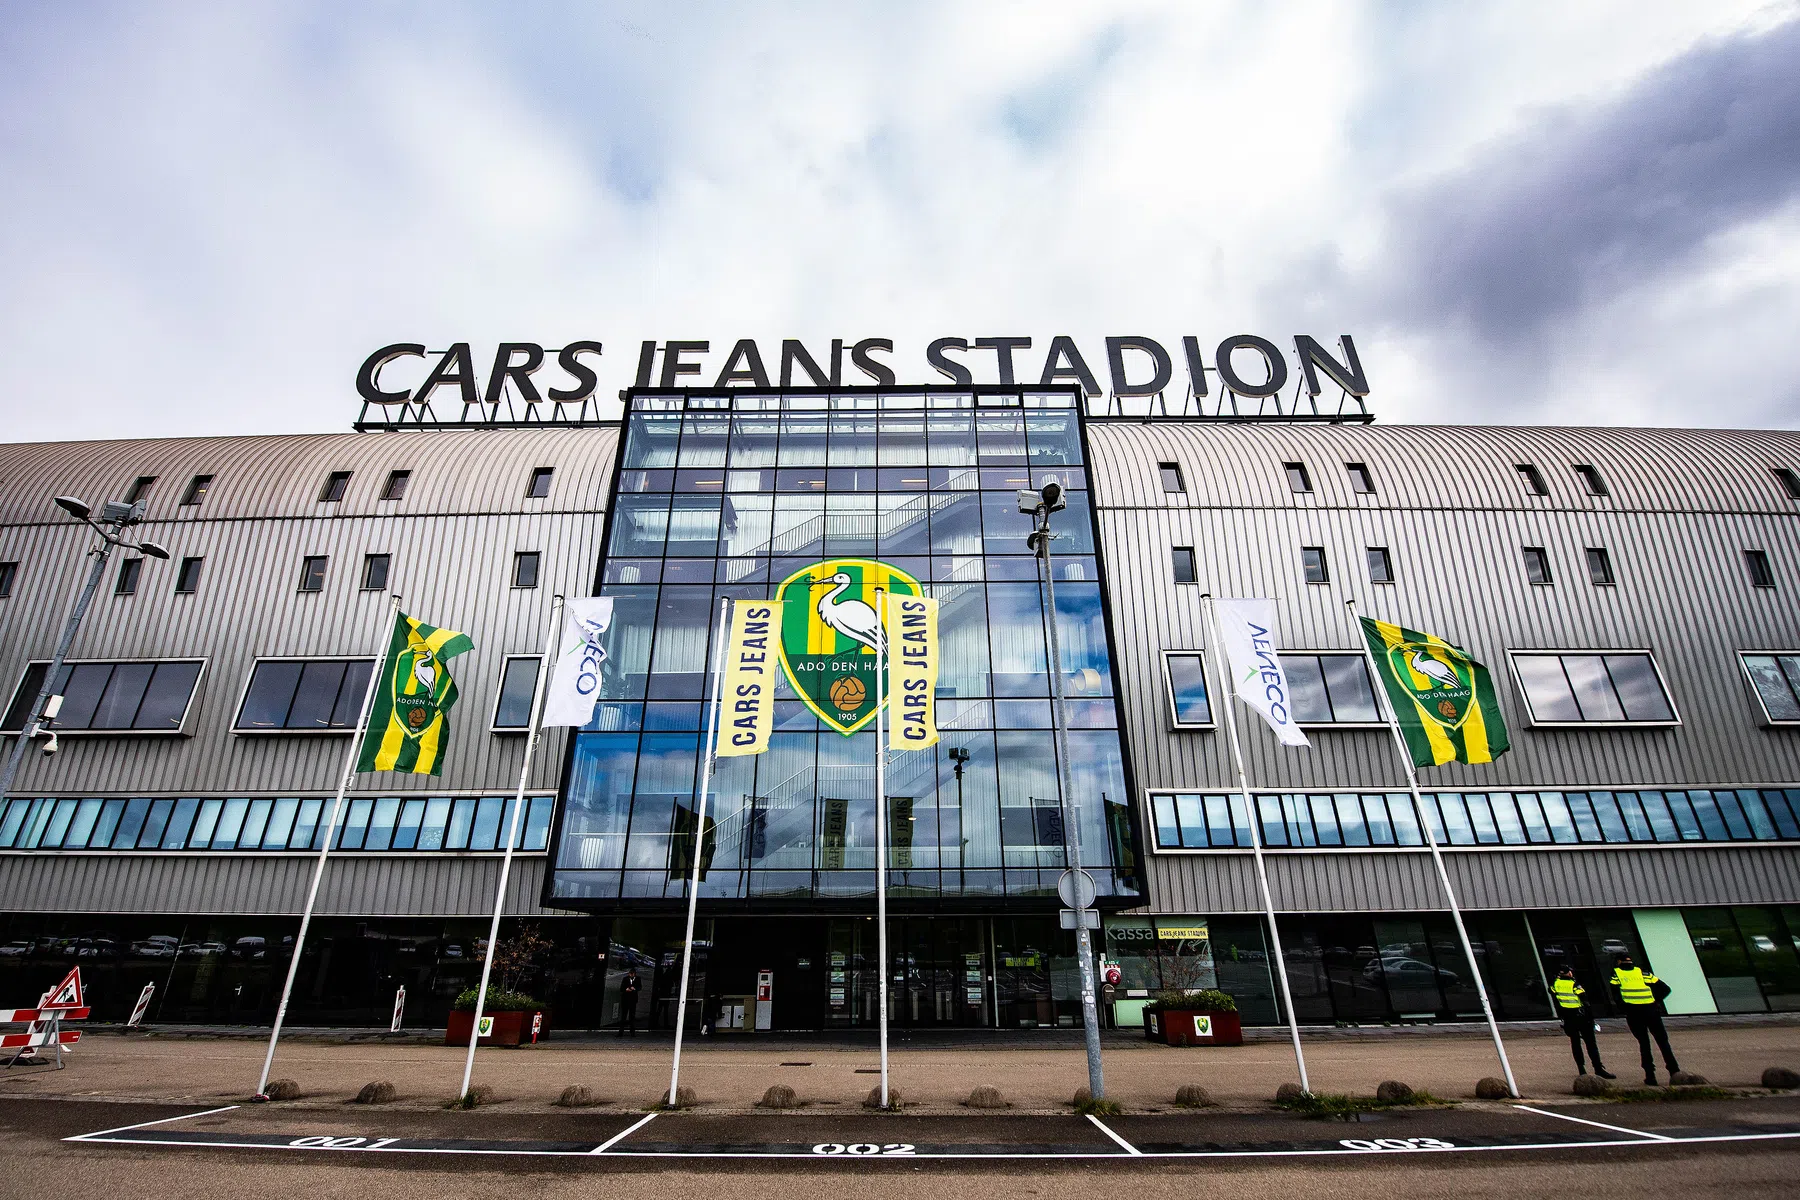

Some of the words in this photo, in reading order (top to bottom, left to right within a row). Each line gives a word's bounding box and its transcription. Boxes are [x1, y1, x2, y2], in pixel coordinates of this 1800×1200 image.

[355, 341, 603, 404] CARS
[620, 338, 896, 398] JEANS
[926, 334, 1371, 398] STADION
[739, 608, 771, 675] JEANS
[902, 601, 928, 668] JEANS
[797, 661, 826, 672] ADO
[832, 661, 858, 672] DEN
[1447, 689, 1471, 698] HAAG
[396, 697, 411, 705] ADO
[732, 683, 761, 746] CARS
[837, 712, 857, 721] 1905
[903, 679, 927, 741] CARS
[1104, 924, 1154, 940] Kassa
[289, 1136, 401, 1149] 001
[812, 1143, 916, 1155] 002
[1338, 1137, 1455, 1151] 003
